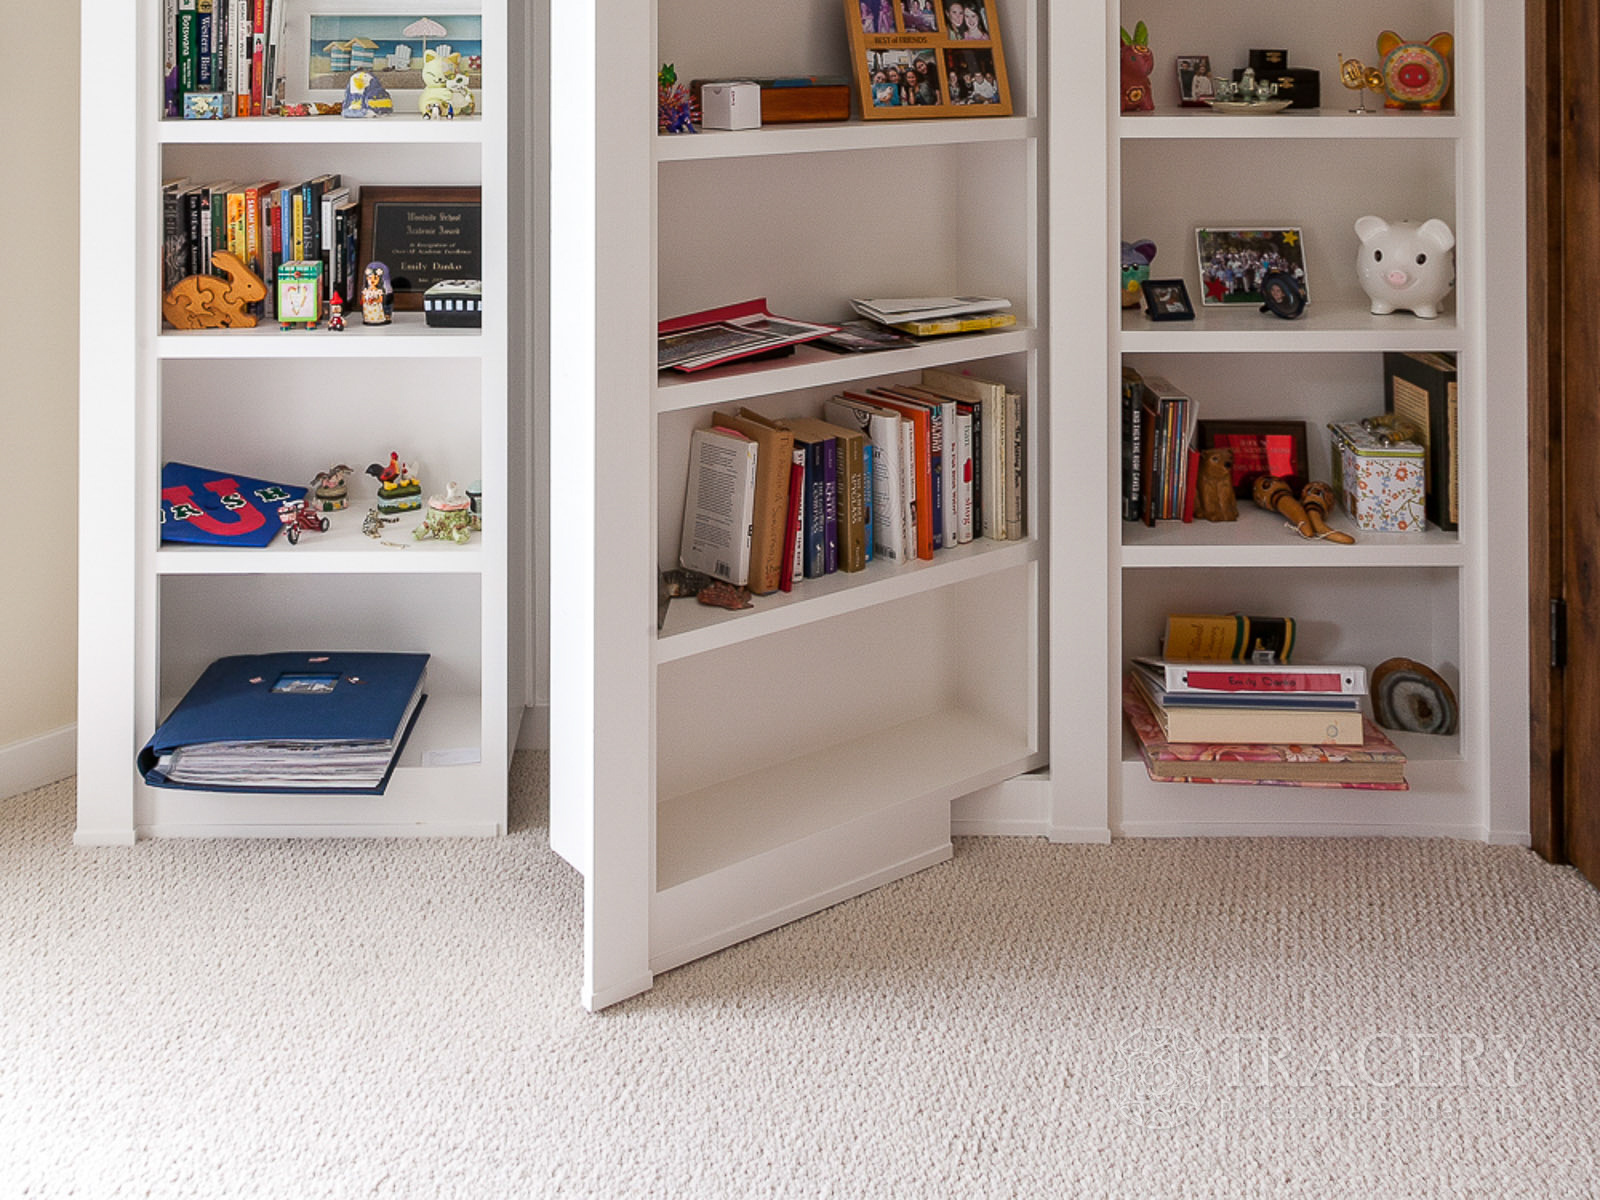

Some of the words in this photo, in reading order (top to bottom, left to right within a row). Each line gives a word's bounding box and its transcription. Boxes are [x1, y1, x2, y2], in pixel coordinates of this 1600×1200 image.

[182, 15, 192, 56] Botswana
[200, 16, 211, 53] Western
[200, 56, 211, 80] Birds
[247, 200, 255, 223] SARAH
[247, 224, 255, 252] VOWELL
[401, 262, 428, 271] Emily
[1132, 410, 1141, 423] AND
[1132, 425, 1141, 441] THEN
[1132, 442, 1141, 453] THE
[1132, 455, 1141, 471] ROOF
[1132, 473, 1141, 492] CAVED
[811, 482, 819, 534] COMPASS
